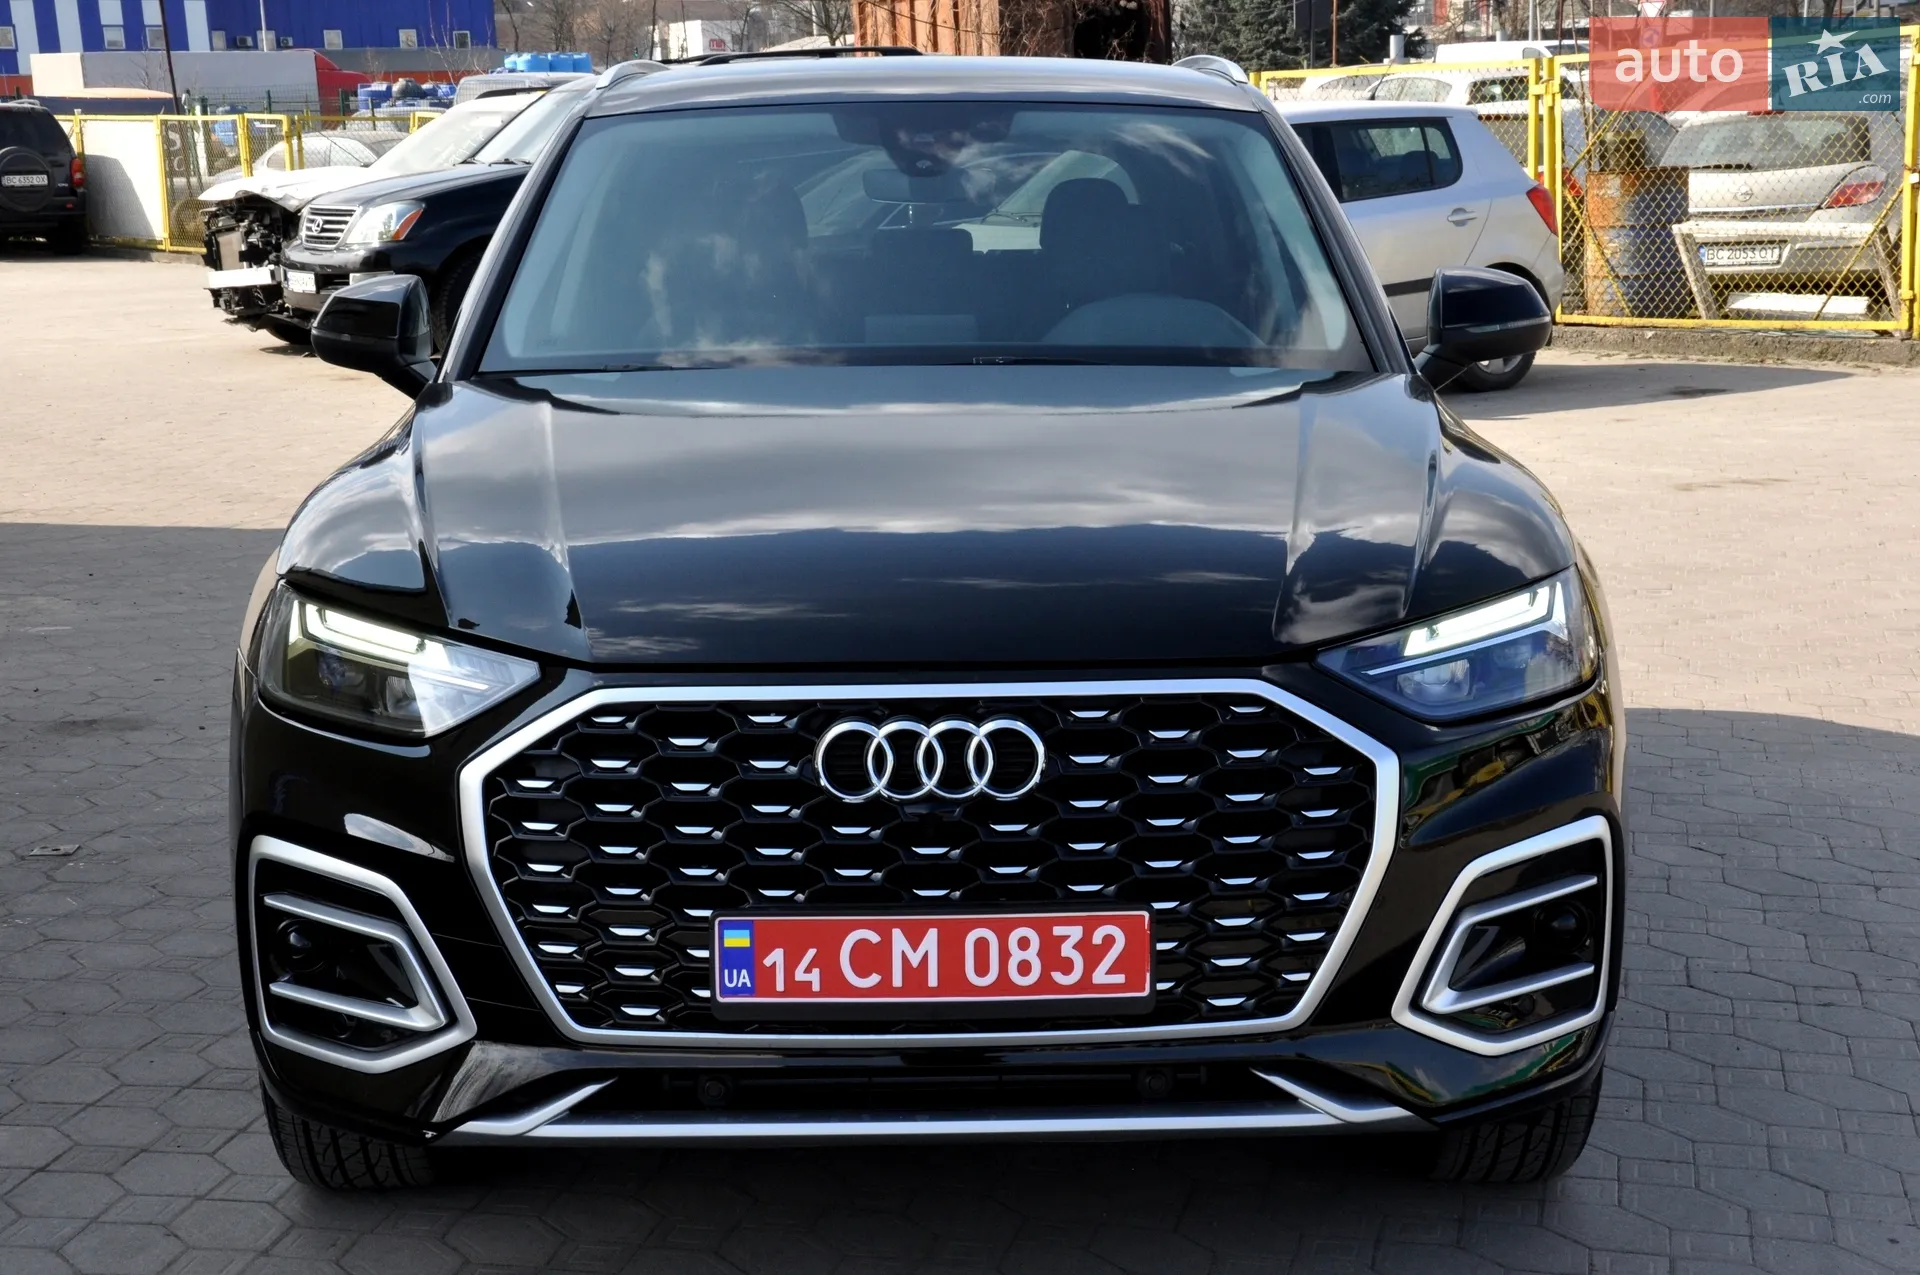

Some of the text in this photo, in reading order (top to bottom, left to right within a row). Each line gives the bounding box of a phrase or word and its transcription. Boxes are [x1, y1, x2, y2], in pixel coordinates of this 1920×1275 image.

[6, 176, 17, 184] BC
[1706, 248, 1725, 260] BC
[1727, 247, 1756, 260] 2053
[762, 924, 1127, 992] 14 CM 0832
[724, 968, 751, 987] UA
